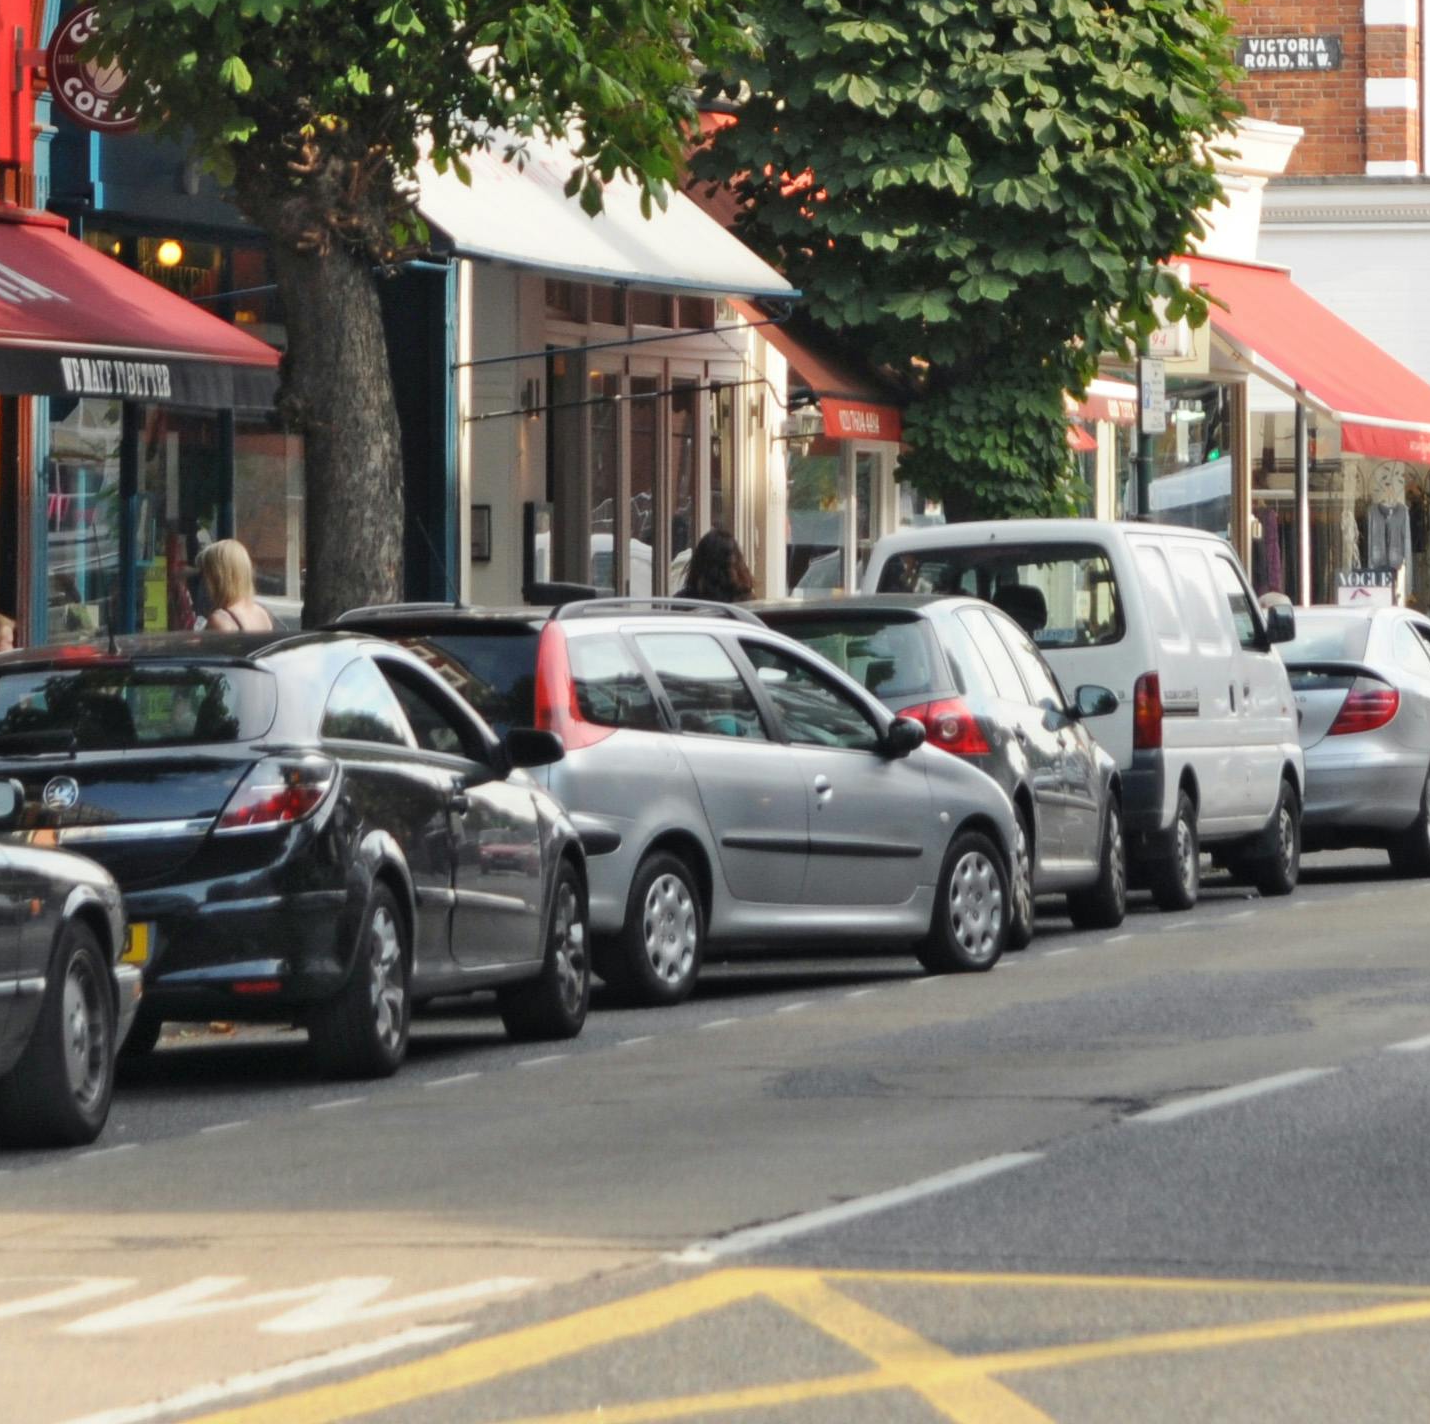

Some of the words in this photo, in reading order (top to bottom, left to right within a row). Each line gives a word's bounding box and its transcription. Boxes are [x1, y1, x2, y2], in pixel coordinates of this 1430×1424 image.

[1248, 38, 1327, 53] VICTORIA
[61, 356, 82, 392] WE
[80, 358, 113, 393] MAKE
[126, 362, 171, 397] BETTER
